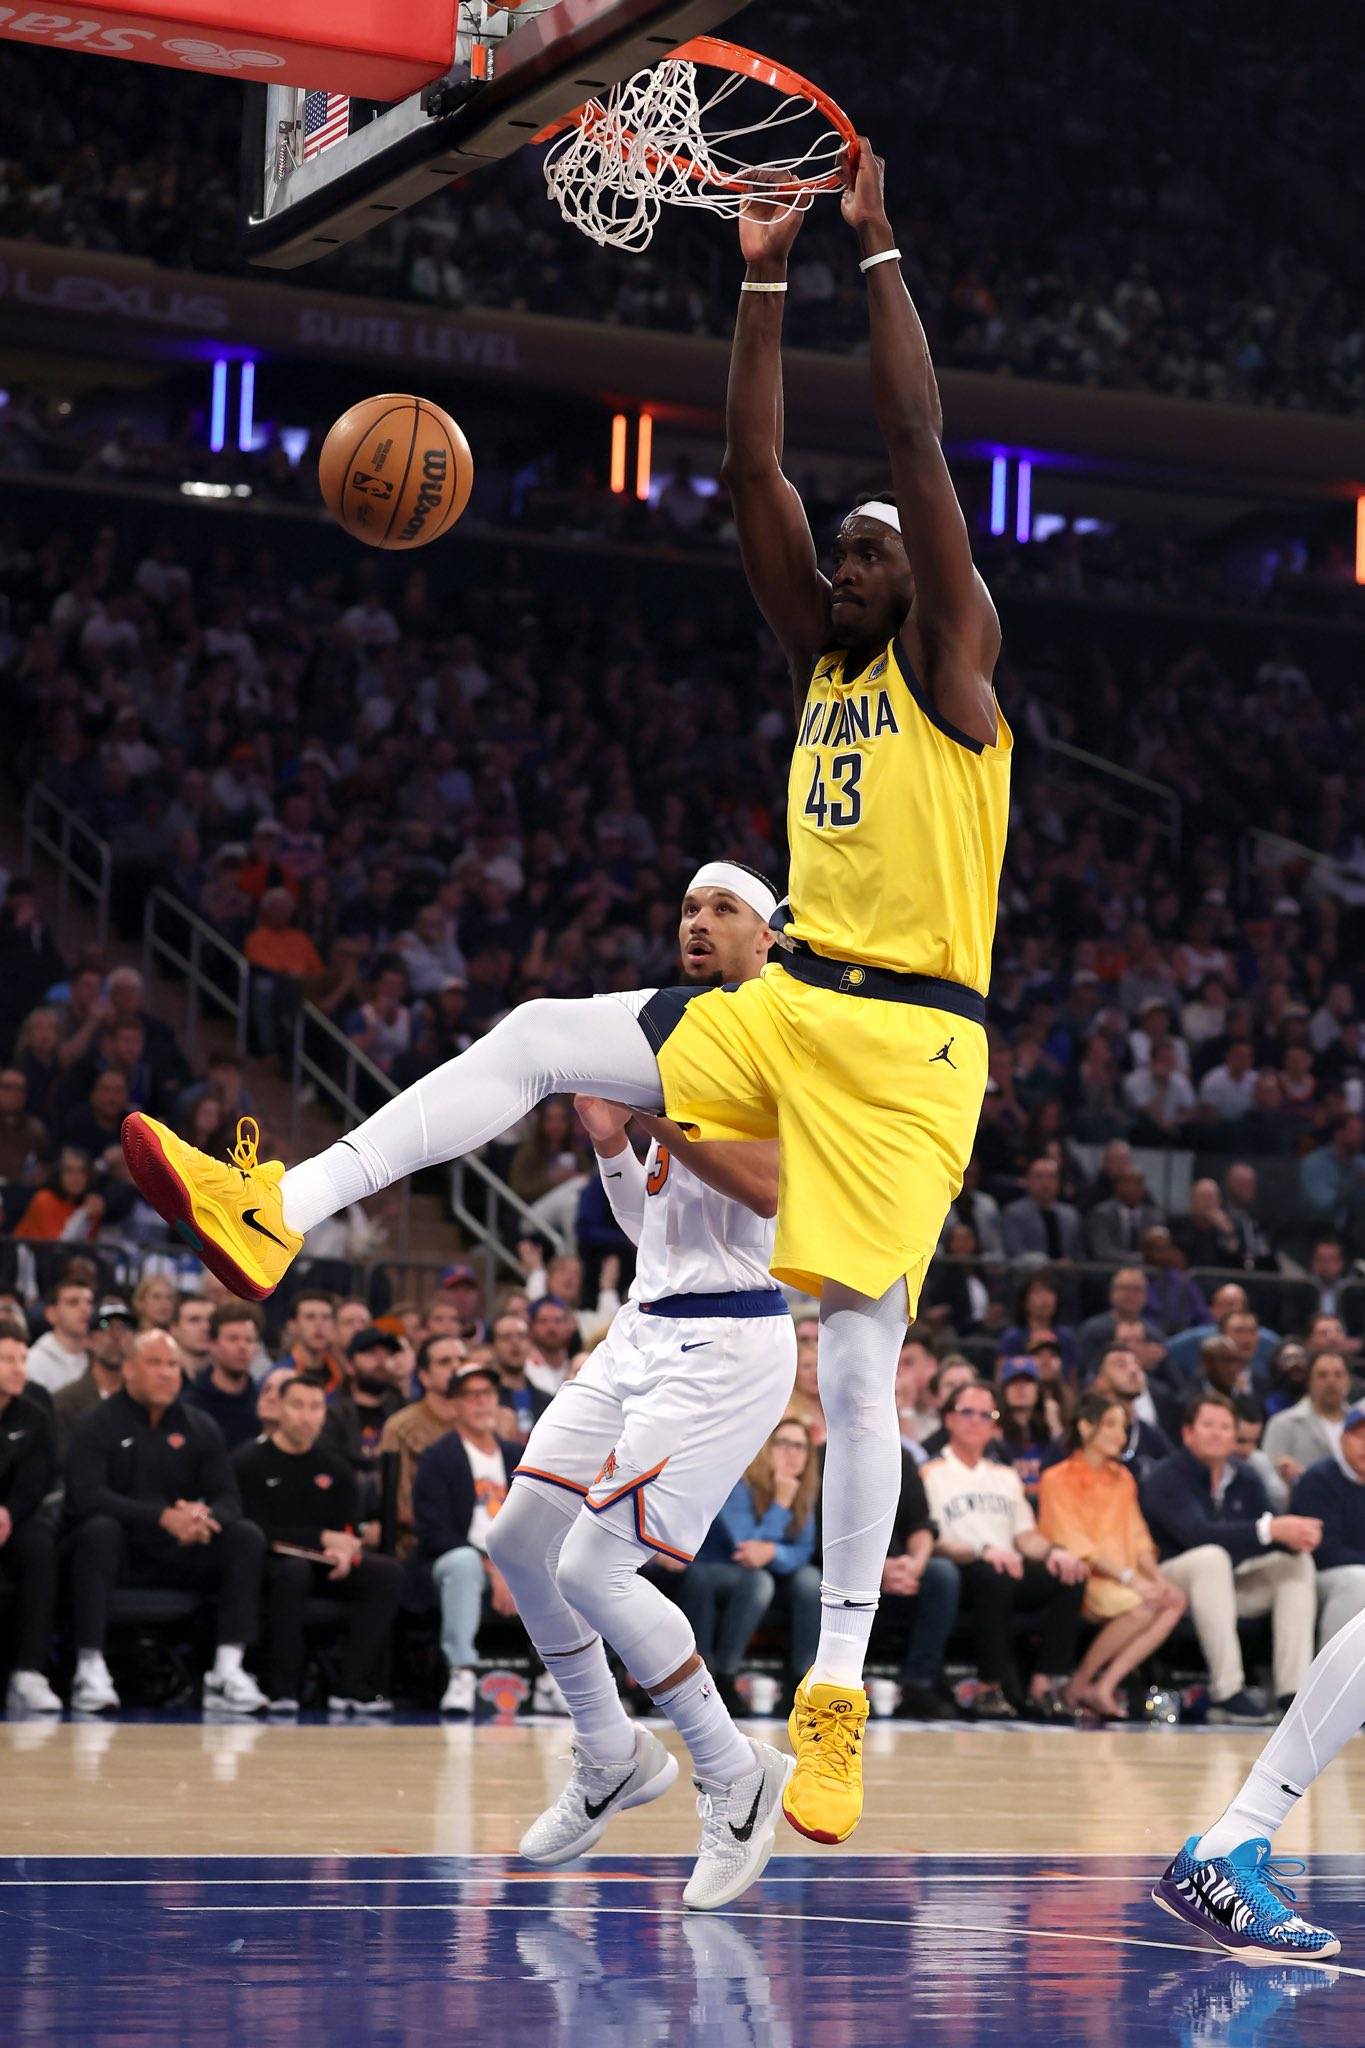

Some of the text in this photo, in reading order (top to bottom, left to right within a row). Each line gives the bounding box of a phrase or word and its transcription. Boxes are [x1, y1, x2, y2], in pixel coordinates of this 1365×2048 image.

[16, 270, 229, 328] LEXUS
[298, 309, 520, 370] SUITE LEVEL
[804, 752, 862, 828] 43
